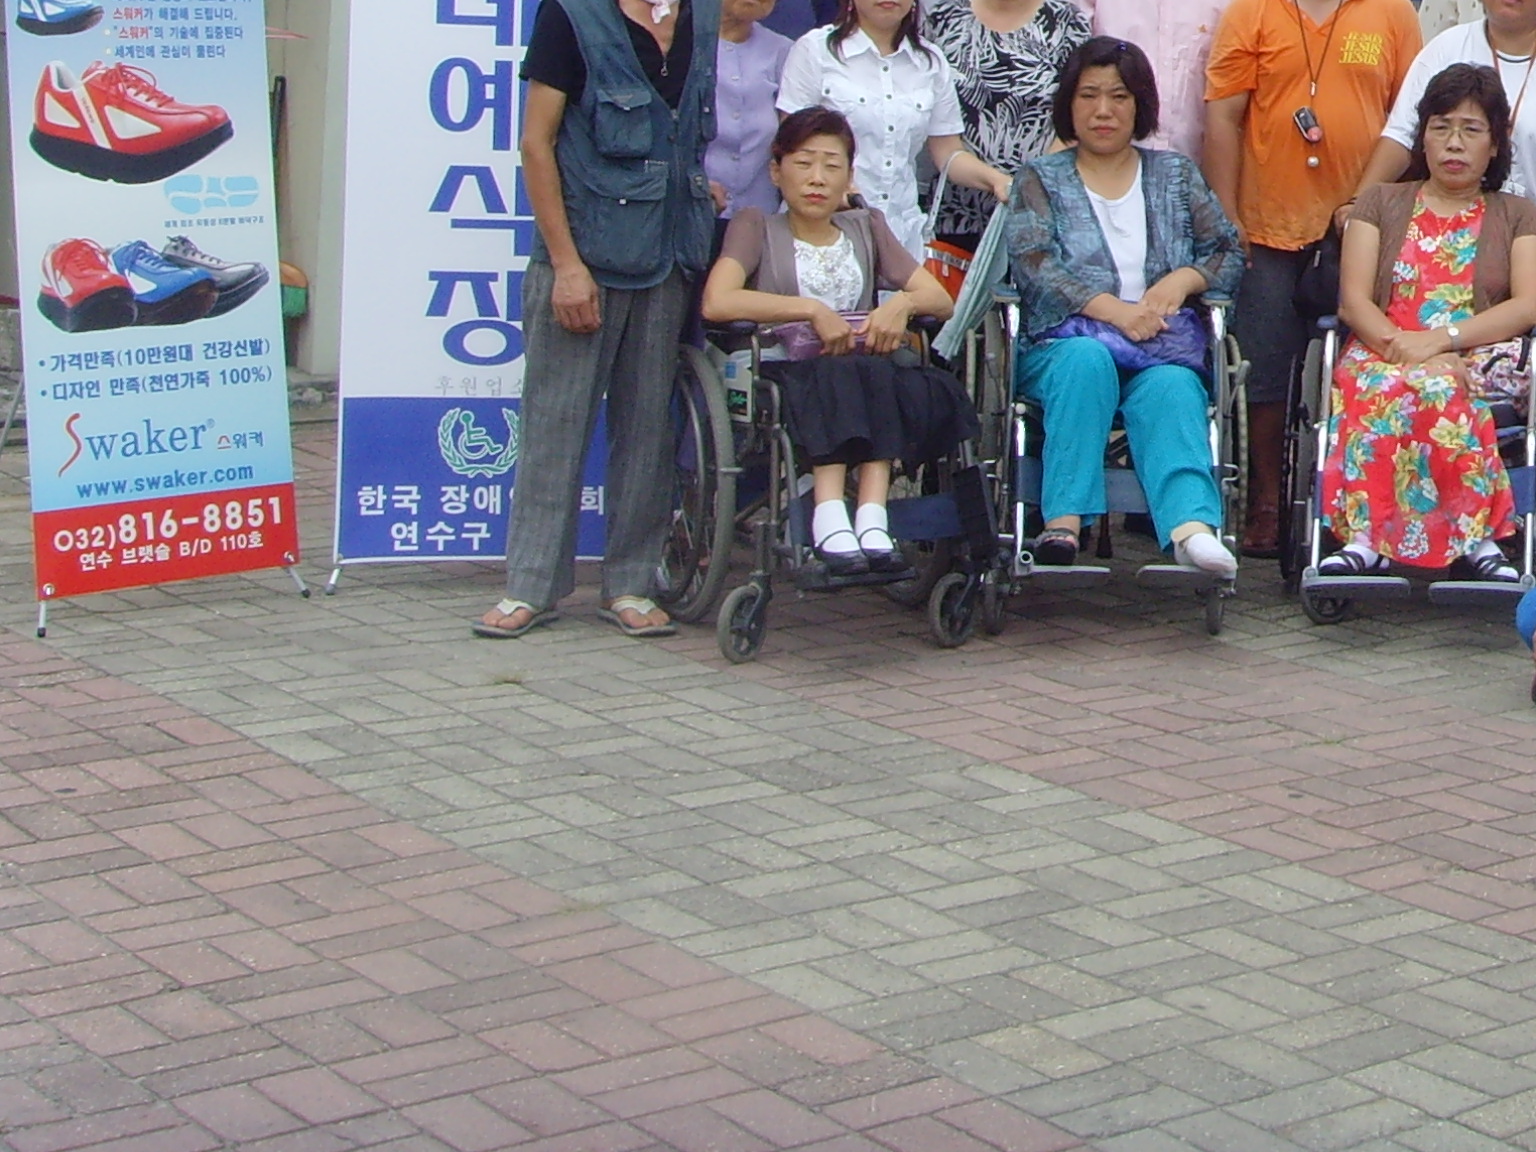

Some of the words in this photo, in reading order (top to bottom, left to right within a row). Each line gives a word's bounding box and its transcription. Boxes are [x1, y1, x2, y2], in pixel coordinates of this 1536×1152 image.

[52, 379, 101, 401] 디자인
[219, 365, 273, 386] 100%)
[76, 464, 254, 499] www.swaker.com
[357, 484, 422, 516] 한국
[79, 550, 114, 573] 연수
[179, 538, 213, 558] B/D
[220, 531, 264, 553] 110호
[390, 521, 492, 552] 연수구
